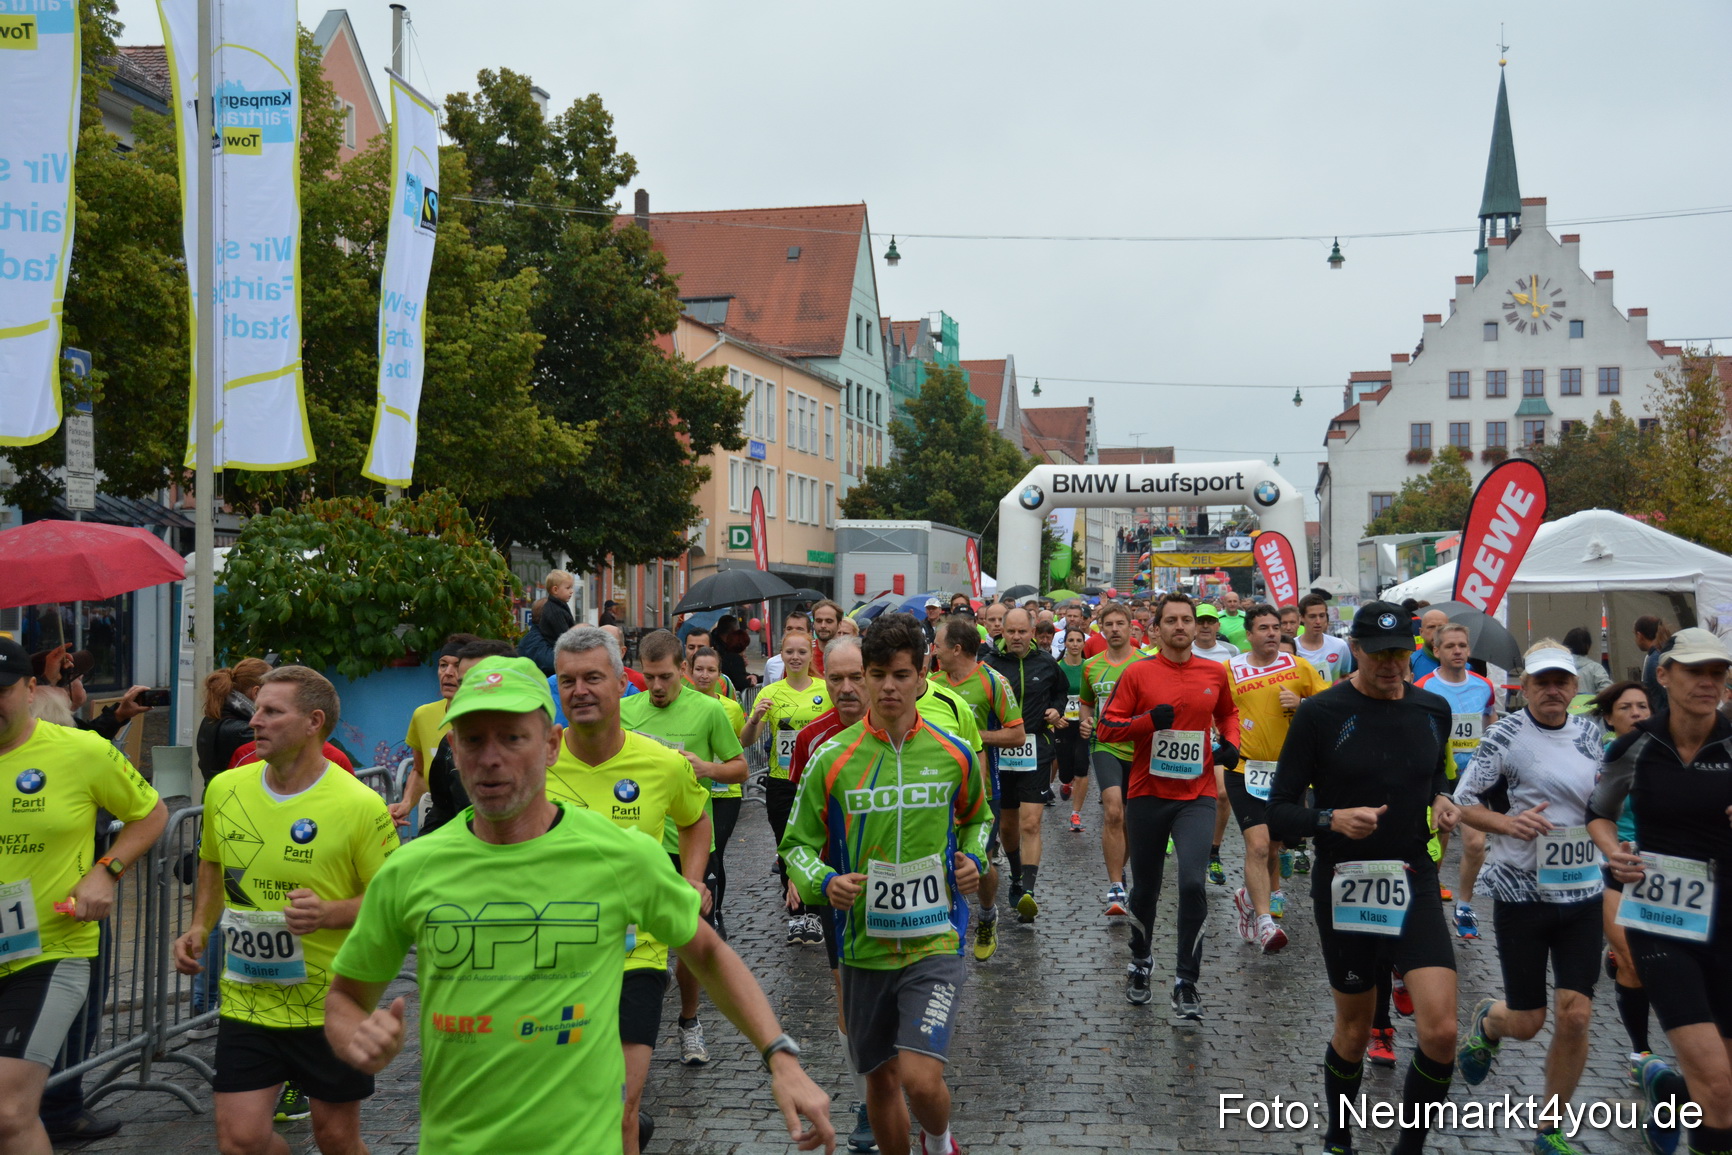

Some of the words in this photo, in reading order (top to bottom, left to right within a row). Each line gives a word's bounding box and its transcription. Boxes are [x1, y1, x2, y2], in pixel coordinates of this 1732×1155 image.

[69, 426, 92, 438] Parkschein
[1053, 474, 1119, 493] BMW
[1126, 471, 1245, 495] Laufsport
[732, 529, 749, 546] D
[1461, 480, 1535, 612] REWE
[1191, 556, 1214, 564] ZIEL
[1236, 681, 1265, 696] MAX
[1268, 671, 1300, 685] BÖGL
[1455, 722, 1473, 737] 49
[1157, 740, 1200, 761] 2896
[1161, 762, 1192, 773] Christian
[12, 797, 45, 808] Partl
[845, 782, 953, 814] BOCK
[612, 806, 640, 815] Partl
[5, 843, 45, 855] YEARS
[284, 845, 314, 859] Partl
[1545, 840, 1595, 865] 2090
[283, 856, 311, 864] Neumarkt
[902, 859, 936, 875] BOCK
[1562, 871, 1582, 881] Erich
[253, 878, 273, 889] THE
[275, 880, 300, 891] NEXT
[874, 875, 939, 910] 2870
[1341, 878, 1406, 906] 2705
[1632, 870, 1706, 909] 2812
[263, 891, 280, 900] 100
[1360, 910, 1388, 923] Klaus
[1640, 907, 1684, 926] Daniela
[228, 926, 295, 959] 2890
[244, 963, 280, 977] Rainer
[432, 1013, 493, 1034] MERZ
[521, 1018, 592, 1036] Bretschneider
